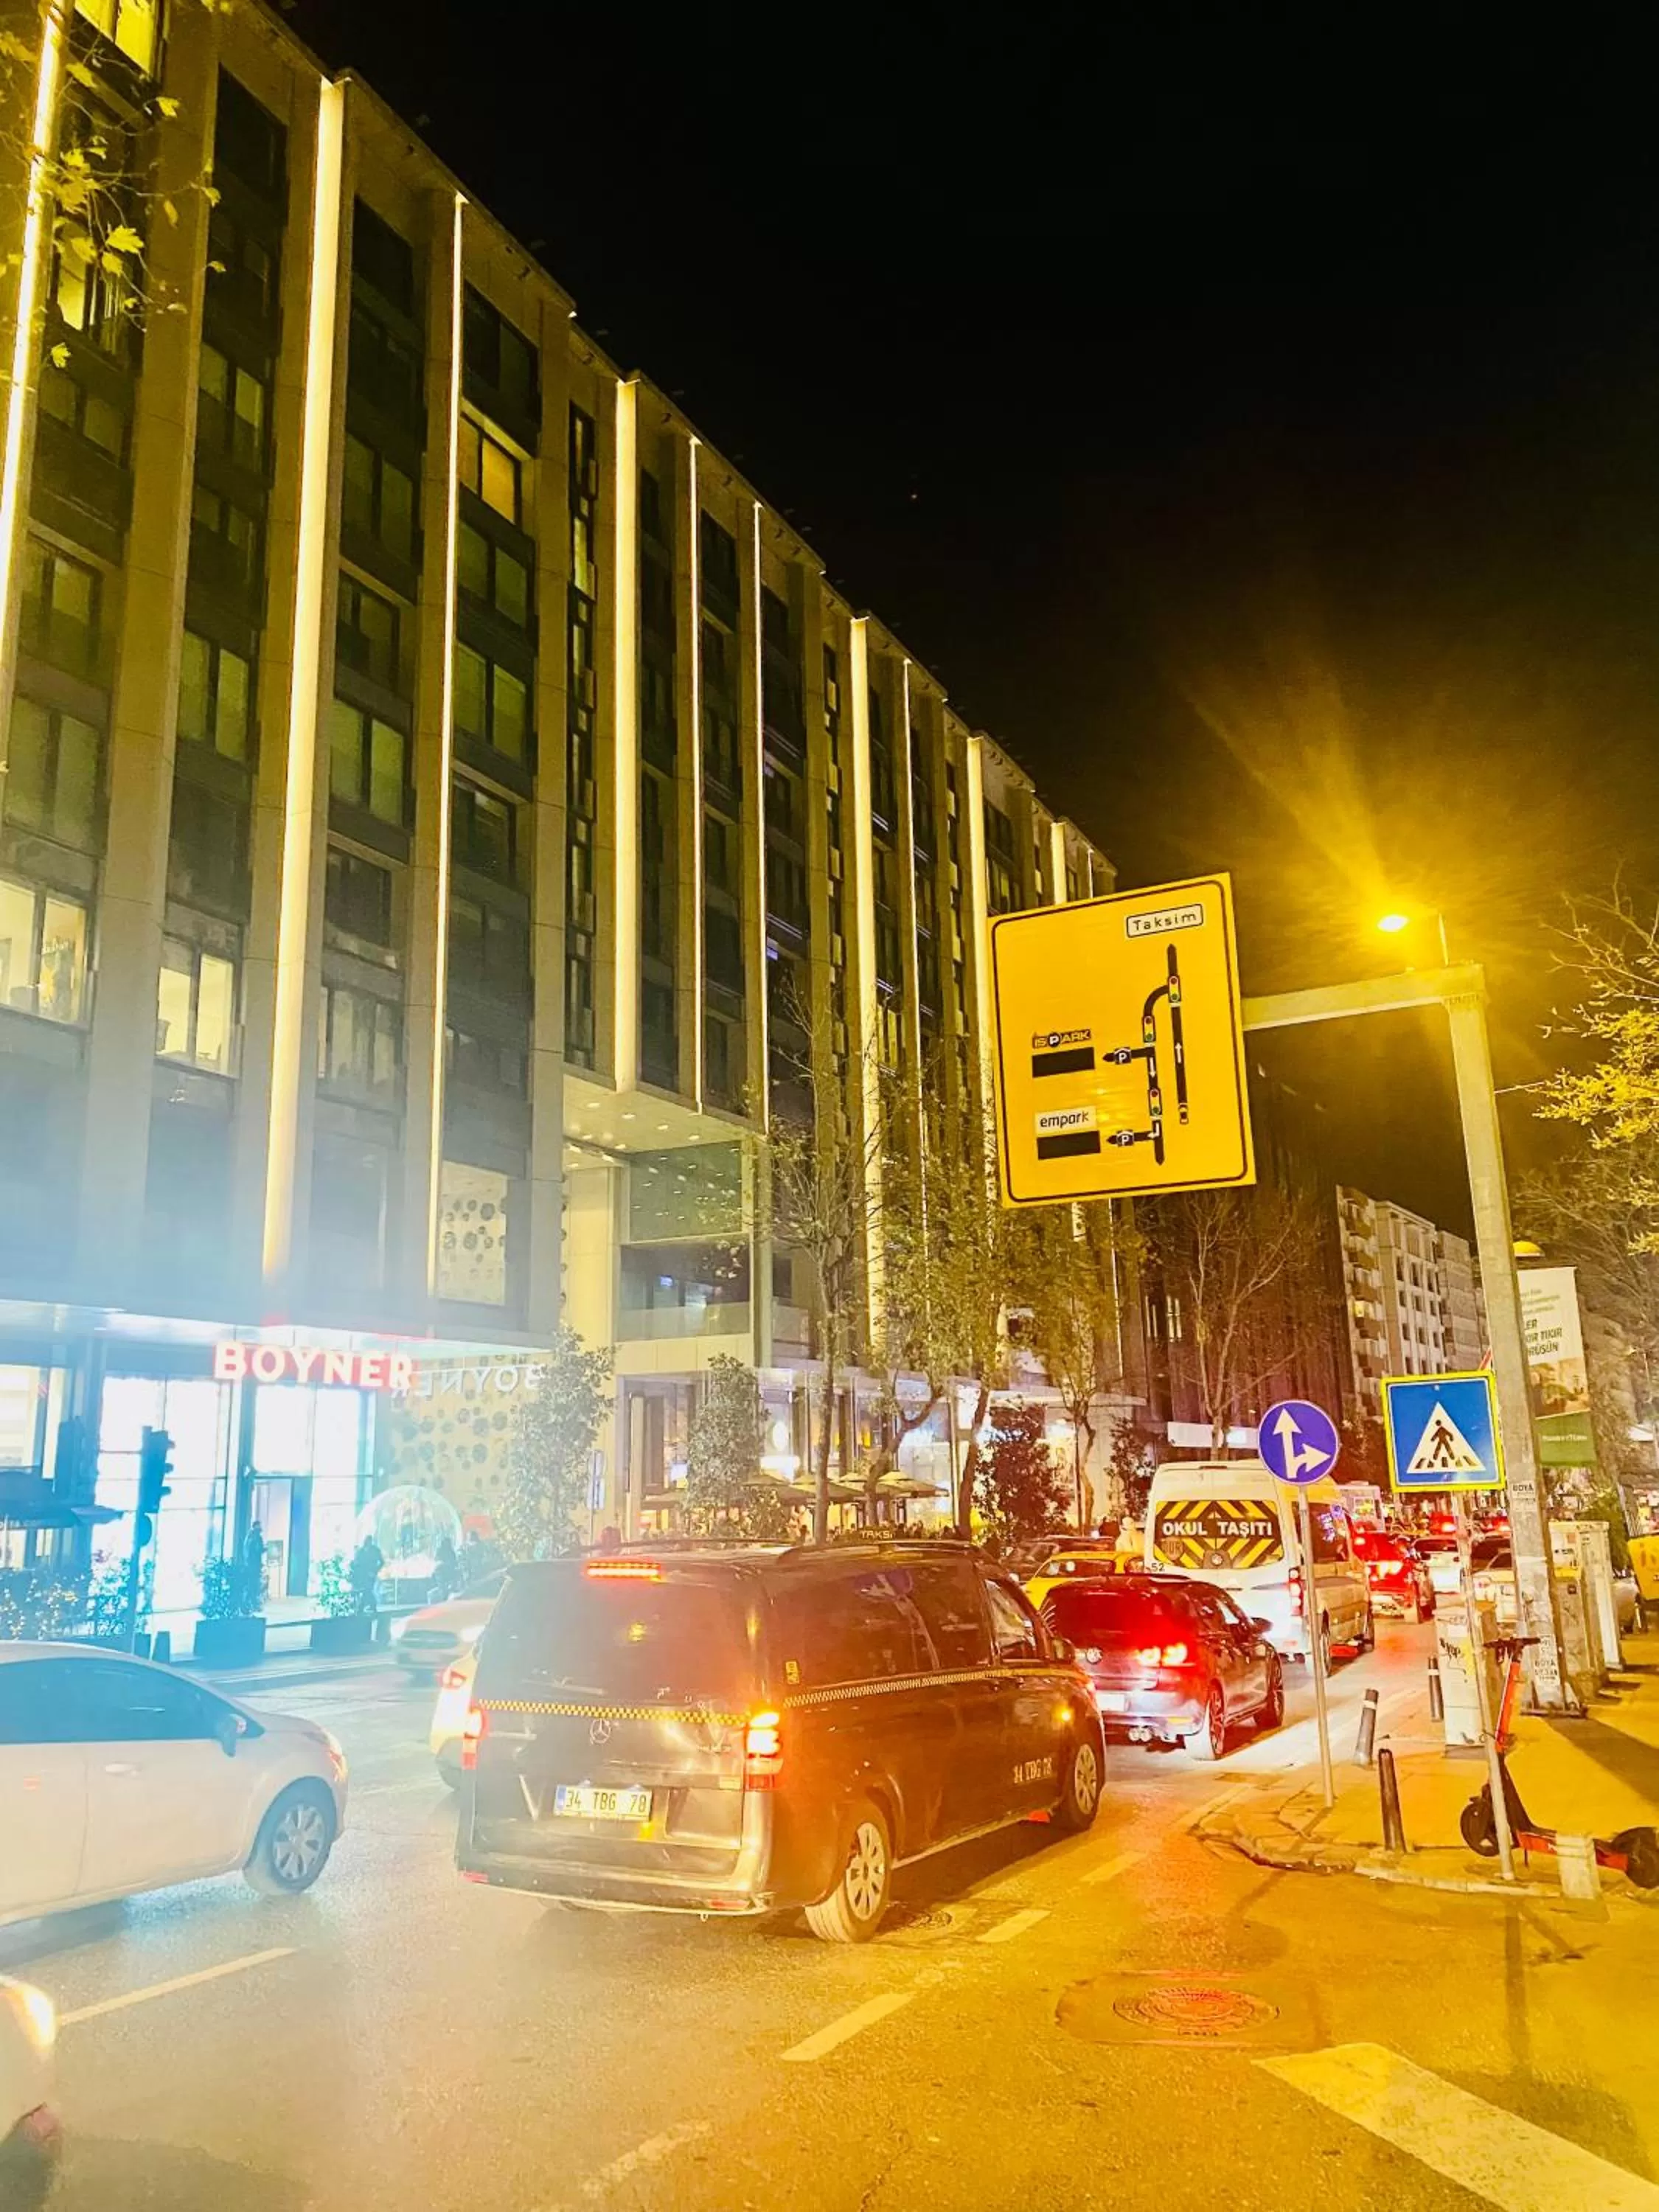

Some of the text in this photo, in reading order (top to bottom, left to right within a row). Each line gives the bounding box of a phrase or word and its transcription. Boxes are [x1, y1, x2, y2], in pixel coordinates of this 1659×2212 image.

[1133, 914, 1196, 931] Taksim
[1040, 1110, 1089, 1128] empark
[215, 1340, 412, 1390] BOYNER
[1162, 1521, 1273, 1539] OKUL TAŞITI
[1151, 1562, 1165, 1572] 52
[566, 1790, 582, 1808] 34
[593, 1791, 617, 1811] TBG
